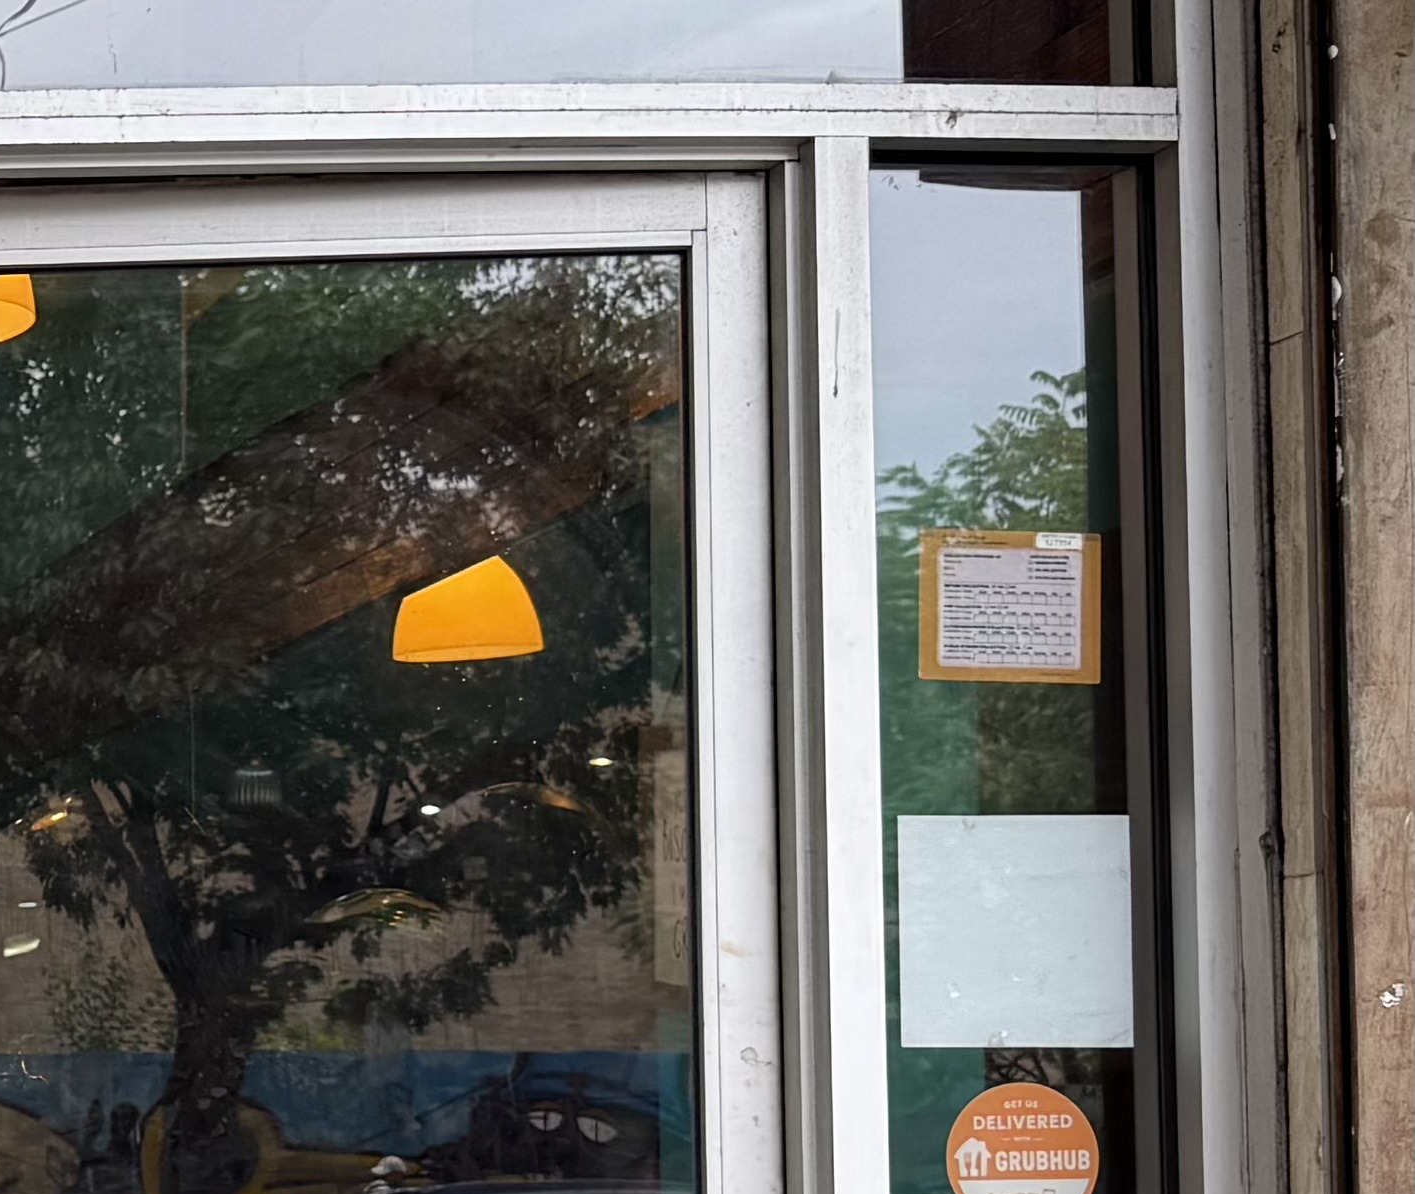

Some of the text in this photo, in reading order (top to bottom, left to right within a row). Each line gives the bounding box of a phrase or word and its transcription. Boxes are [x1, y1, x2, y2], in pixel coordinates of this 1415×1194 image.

[1003, 1099, 1023, 1110] GET
[972, 1114, 1074, 1131] DELIVERED
[994, 1148, 1091, 1173] GRUBHUB
